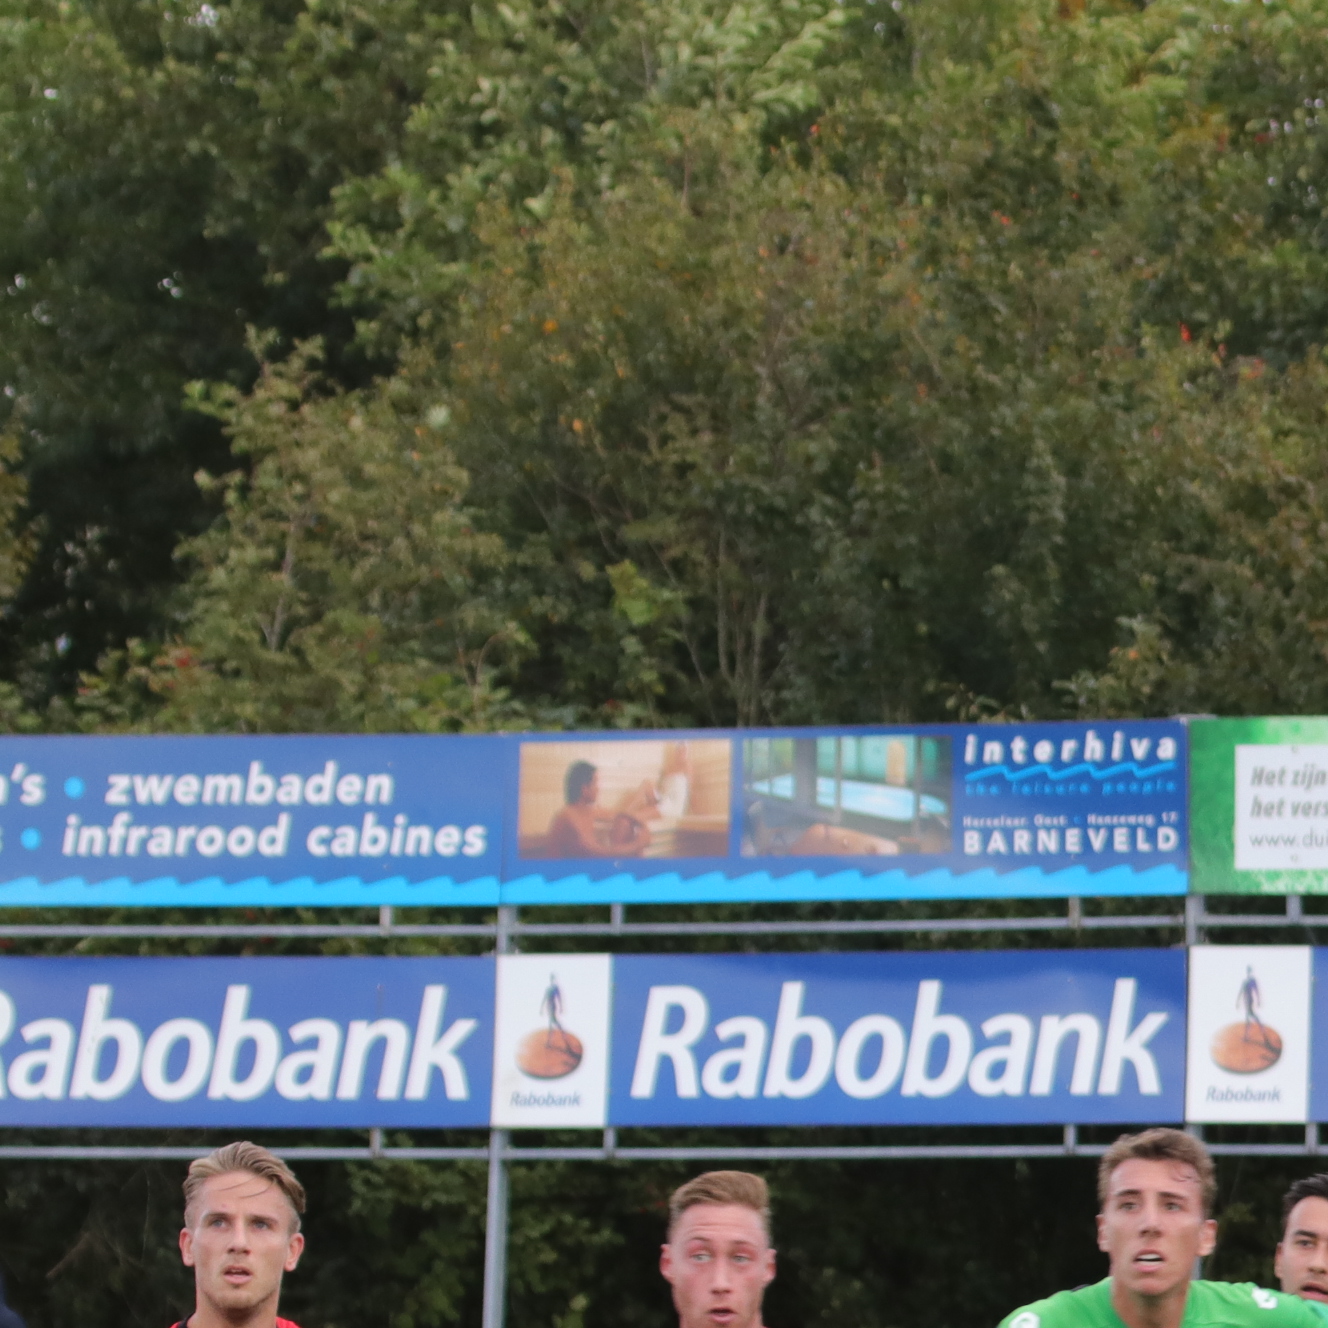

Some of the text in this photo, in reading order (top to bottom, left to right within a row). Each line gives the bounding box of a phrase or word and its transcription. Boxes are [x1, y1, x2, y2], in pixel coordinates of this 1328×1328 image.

[964, 729, 1177, 765] interhiva
[104, 761, 393, 806] zwembaden
[1250, 765, 1286, 787] Het
[1291, 765, 1326, 790] zijn
[1250, 795, 1284, 817] het
[62, 811, 487, 857] infrarood cabines
[963, 826, 1179, 855] BARNEVELD
[0, 984, 478, 1101] abobank
[630, 978, 1169, 1099] Rabobank
[510, 1090, 582, 1107] Rabobank
[1206, 1085, 1281, 1103] Rabobank
